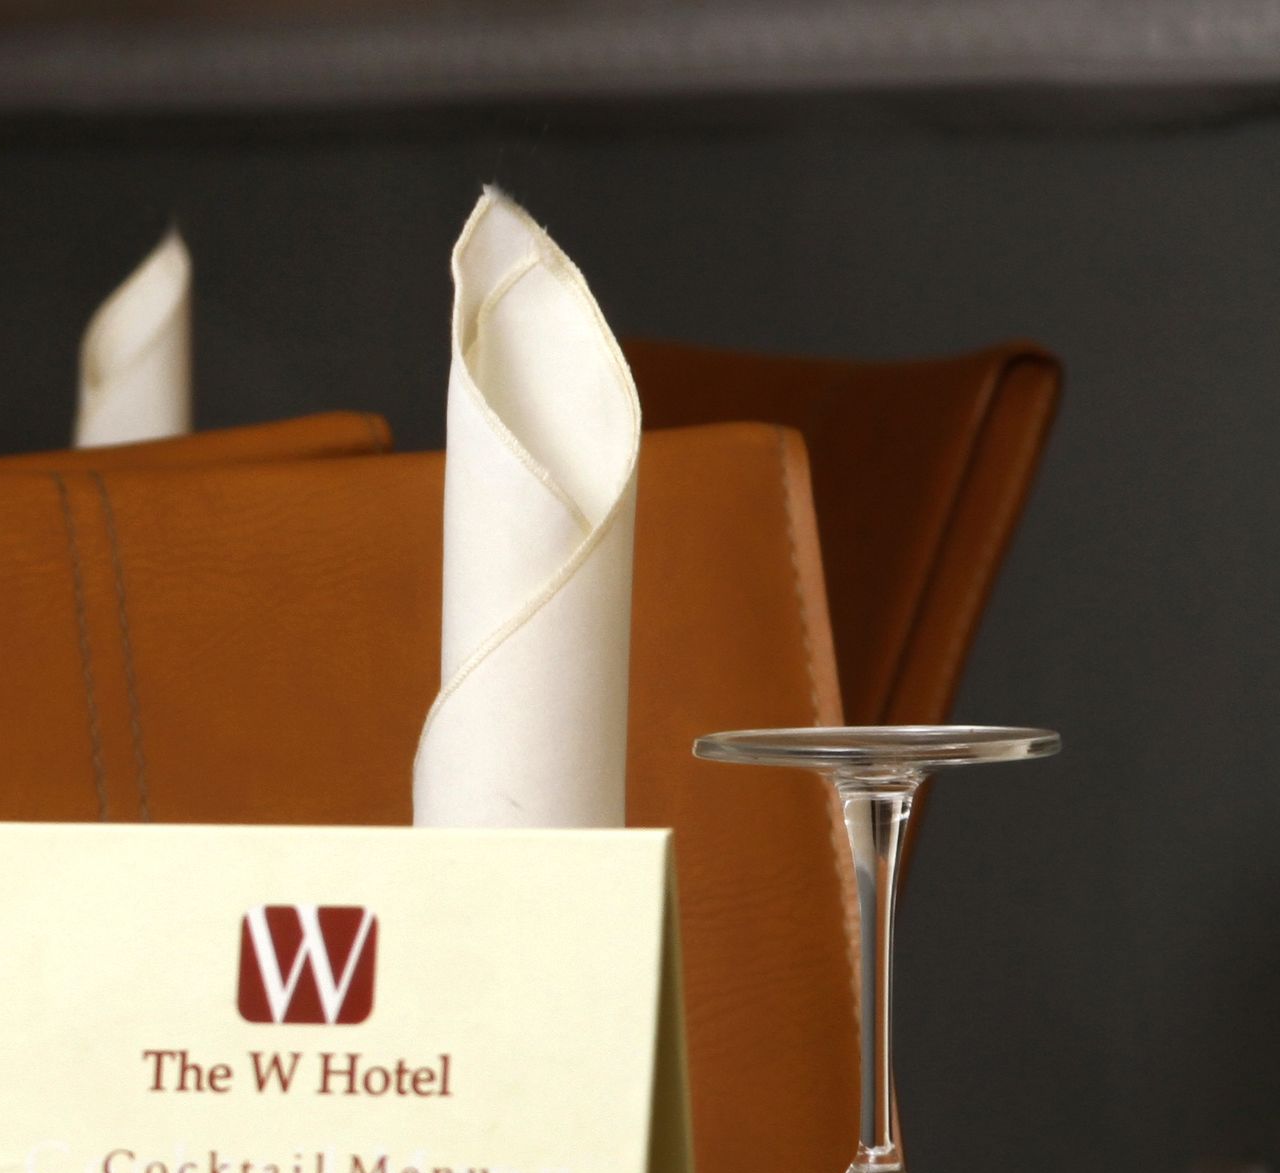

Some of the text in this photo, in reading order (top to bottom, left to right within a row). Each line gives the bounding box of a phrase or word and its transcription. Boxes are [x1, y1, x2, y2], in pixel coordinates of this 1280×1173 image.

[240, 905, 376, 1024] W
[142, 1049, 453, 1098] The W Hotel
